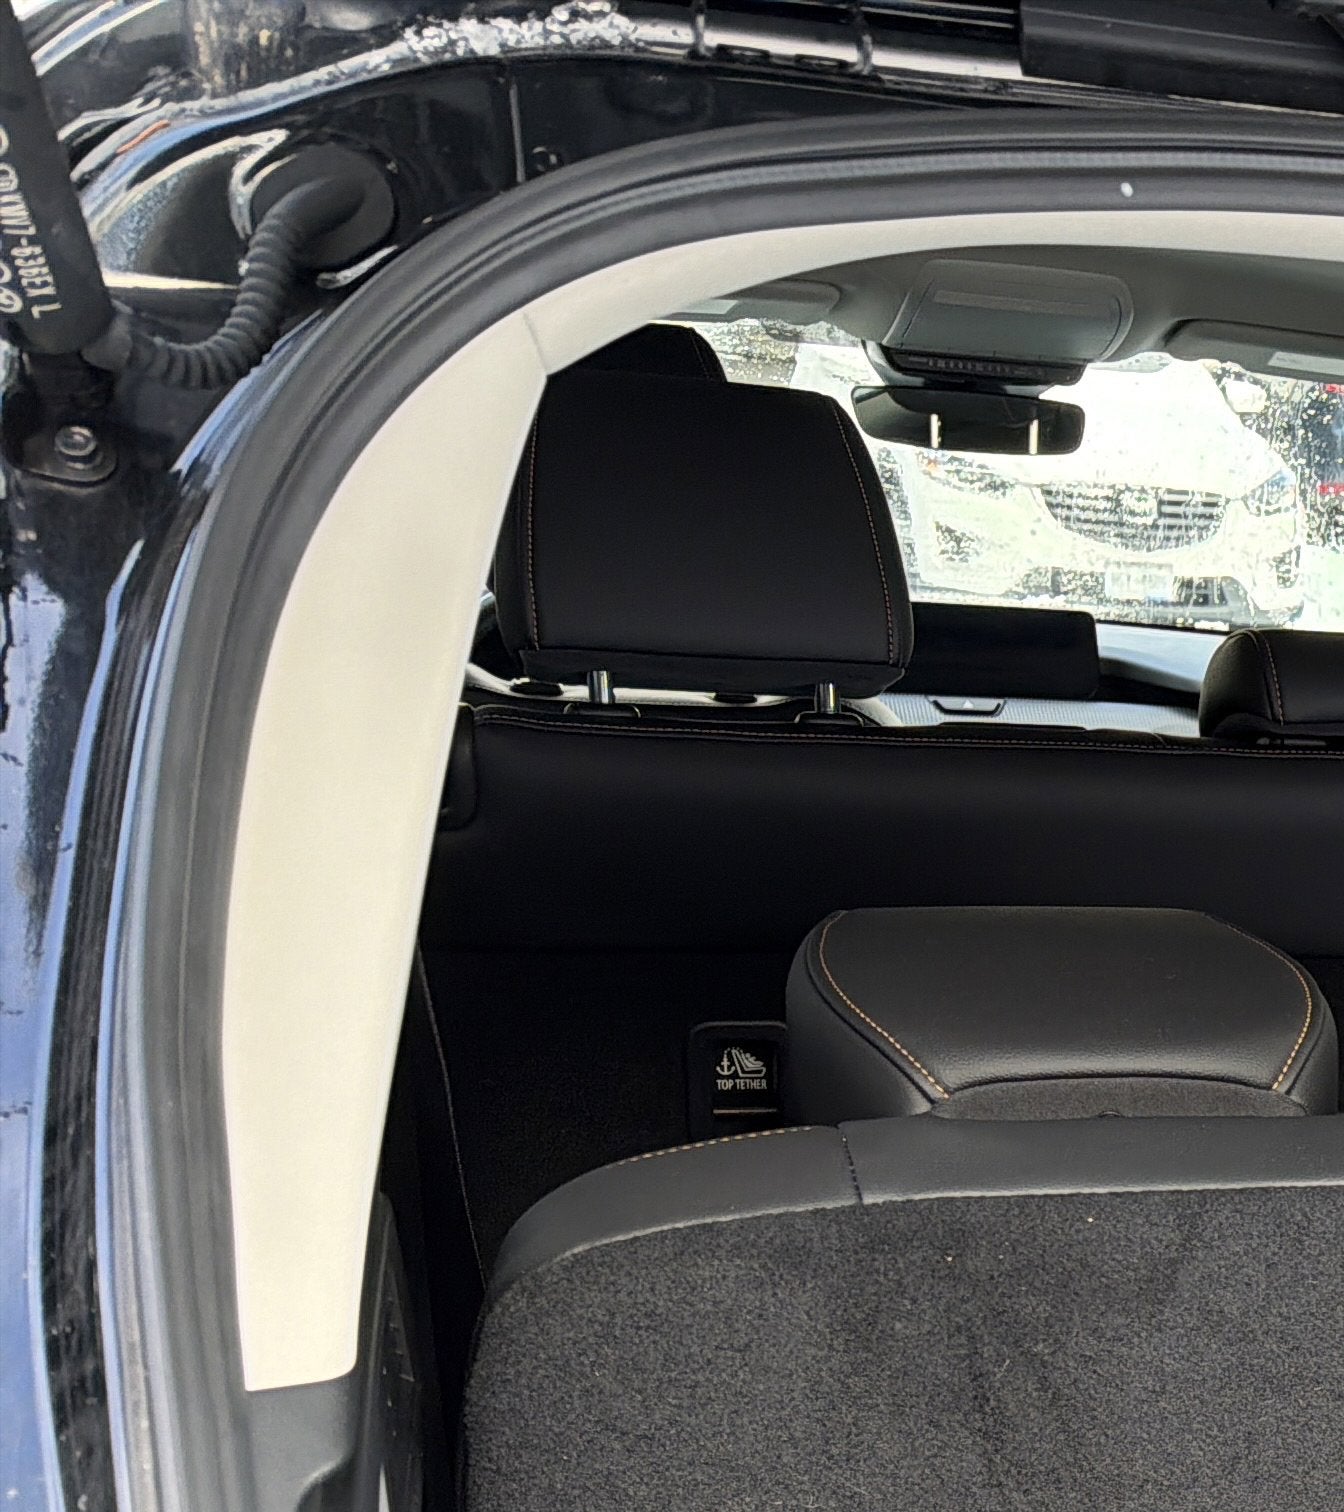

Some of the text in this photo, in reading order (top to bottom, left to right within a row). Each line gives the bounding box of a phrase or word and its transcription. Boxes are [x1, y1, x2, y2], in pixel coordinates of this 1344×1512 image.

[31, 302, 63, 319] L
[716, 1078, 767, 1090] TOP TETHER
